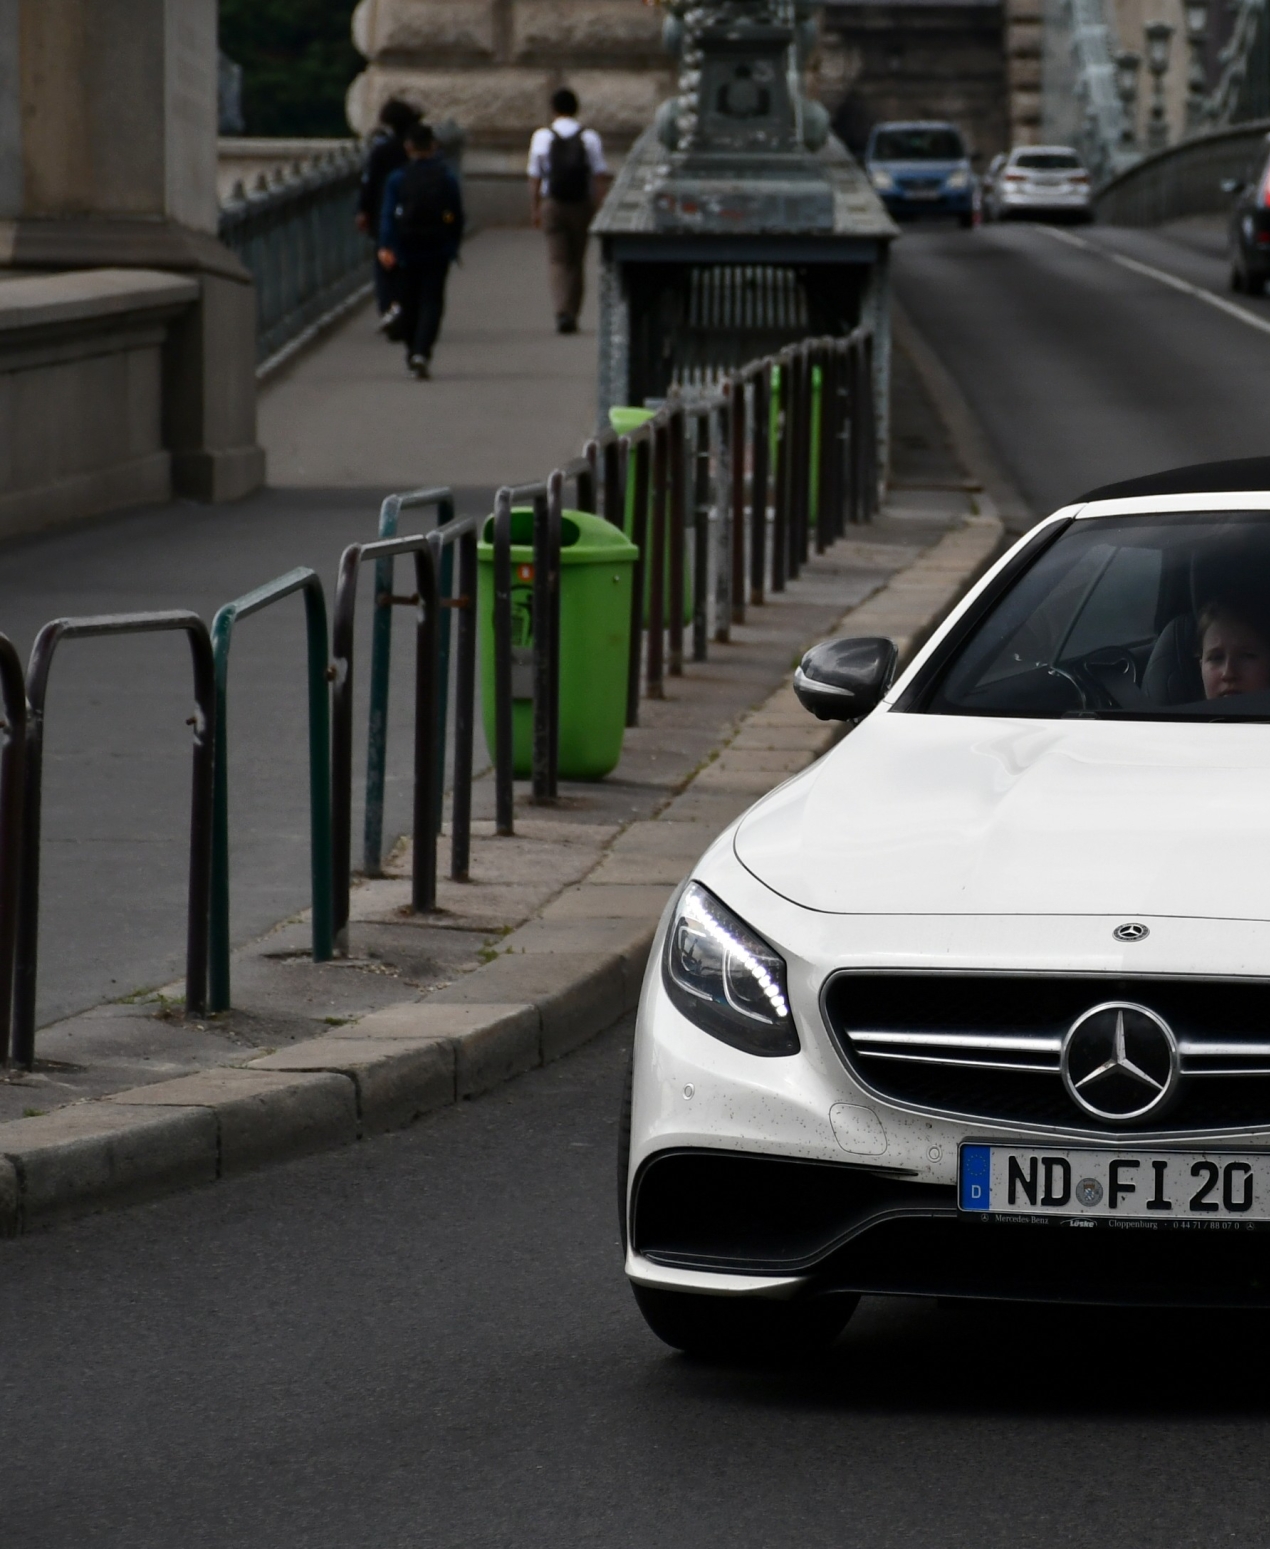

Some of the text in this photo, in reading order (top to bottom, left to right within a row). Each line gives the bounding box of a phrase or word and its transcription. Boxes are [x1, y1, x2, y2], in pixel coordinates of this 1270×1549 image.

[1007, 1155, 1072, 1207] ND
[1108, 1158, 1172, 1210] FI
[1189, 1161, 1254, 1212] 20
[971, 1184, 982, 1199] D
[1108, 1219, 1158, 1230] Cloppenburg
